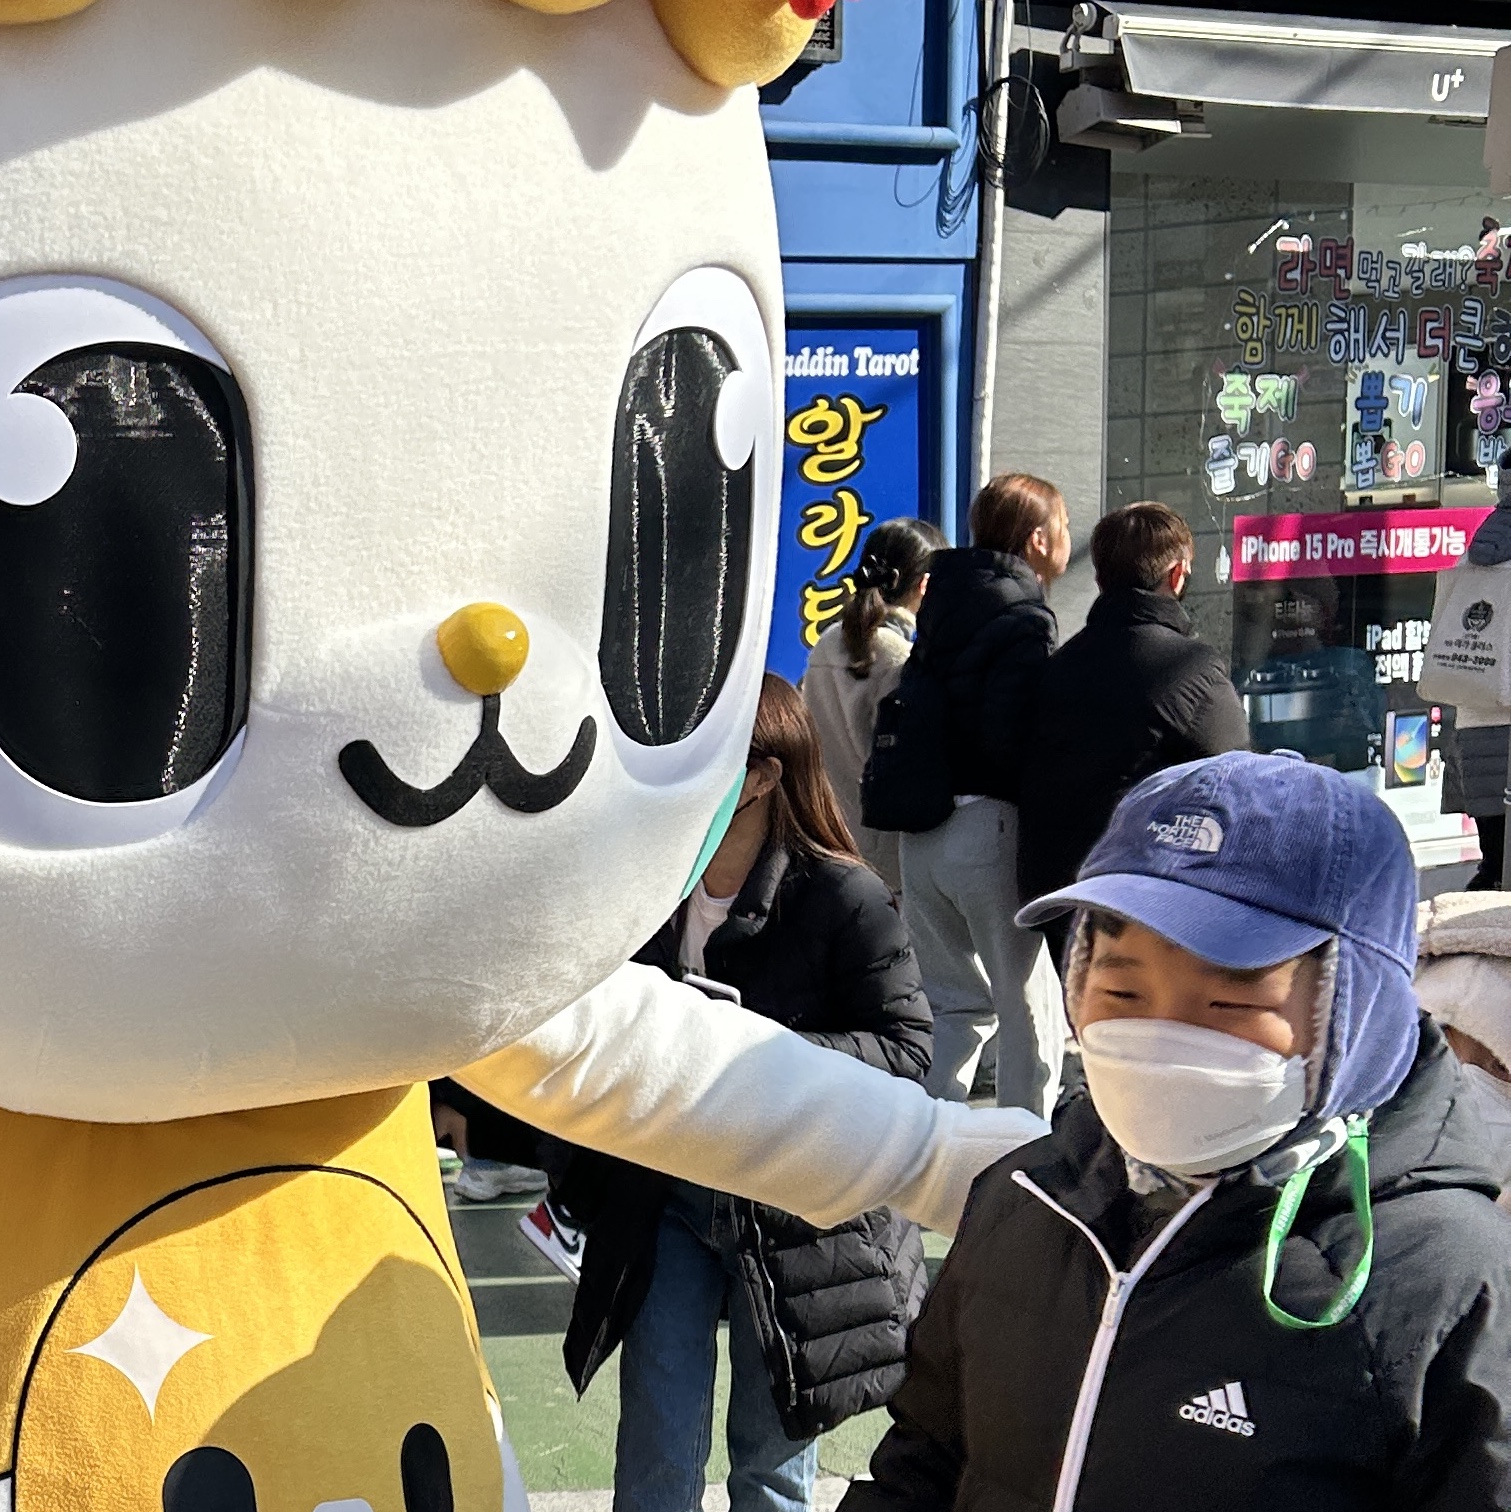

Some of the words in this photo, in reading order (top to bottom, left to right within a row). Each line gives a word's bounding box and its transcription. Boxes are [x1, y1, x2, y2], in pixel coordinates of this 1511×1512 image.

[1431, 69, 1465, 102] U+
[1276, 234, 1354, 301] 라면
[1232, 286, 1319, 368] 함께
[1325, 303, 1408, 366] 해서
[785, 347, 849, 377] addin
[854, 347, 919, 377] Tarot
[1217, 367, 1298, 437] 축제
[1355, 370, 1427, 433] 뽑기
[1206, 434, 1316, 494] 즐기GO
[1352, 436, 1426, 489] 뽑GO
[1241, 533, 1300, 564] iPhone
[1305, 533, 1323, 561] 15
[1326, 532, 1355, 559] Pro
[1366, 622, 1402, 651] iPad
[1147, 821, 1199, 838] NORTH
[1175, 815, 1204, 828] THE
[1156, 834, 1195, 848] FACE
[1179, 1404, 1257, 1437] adidas
